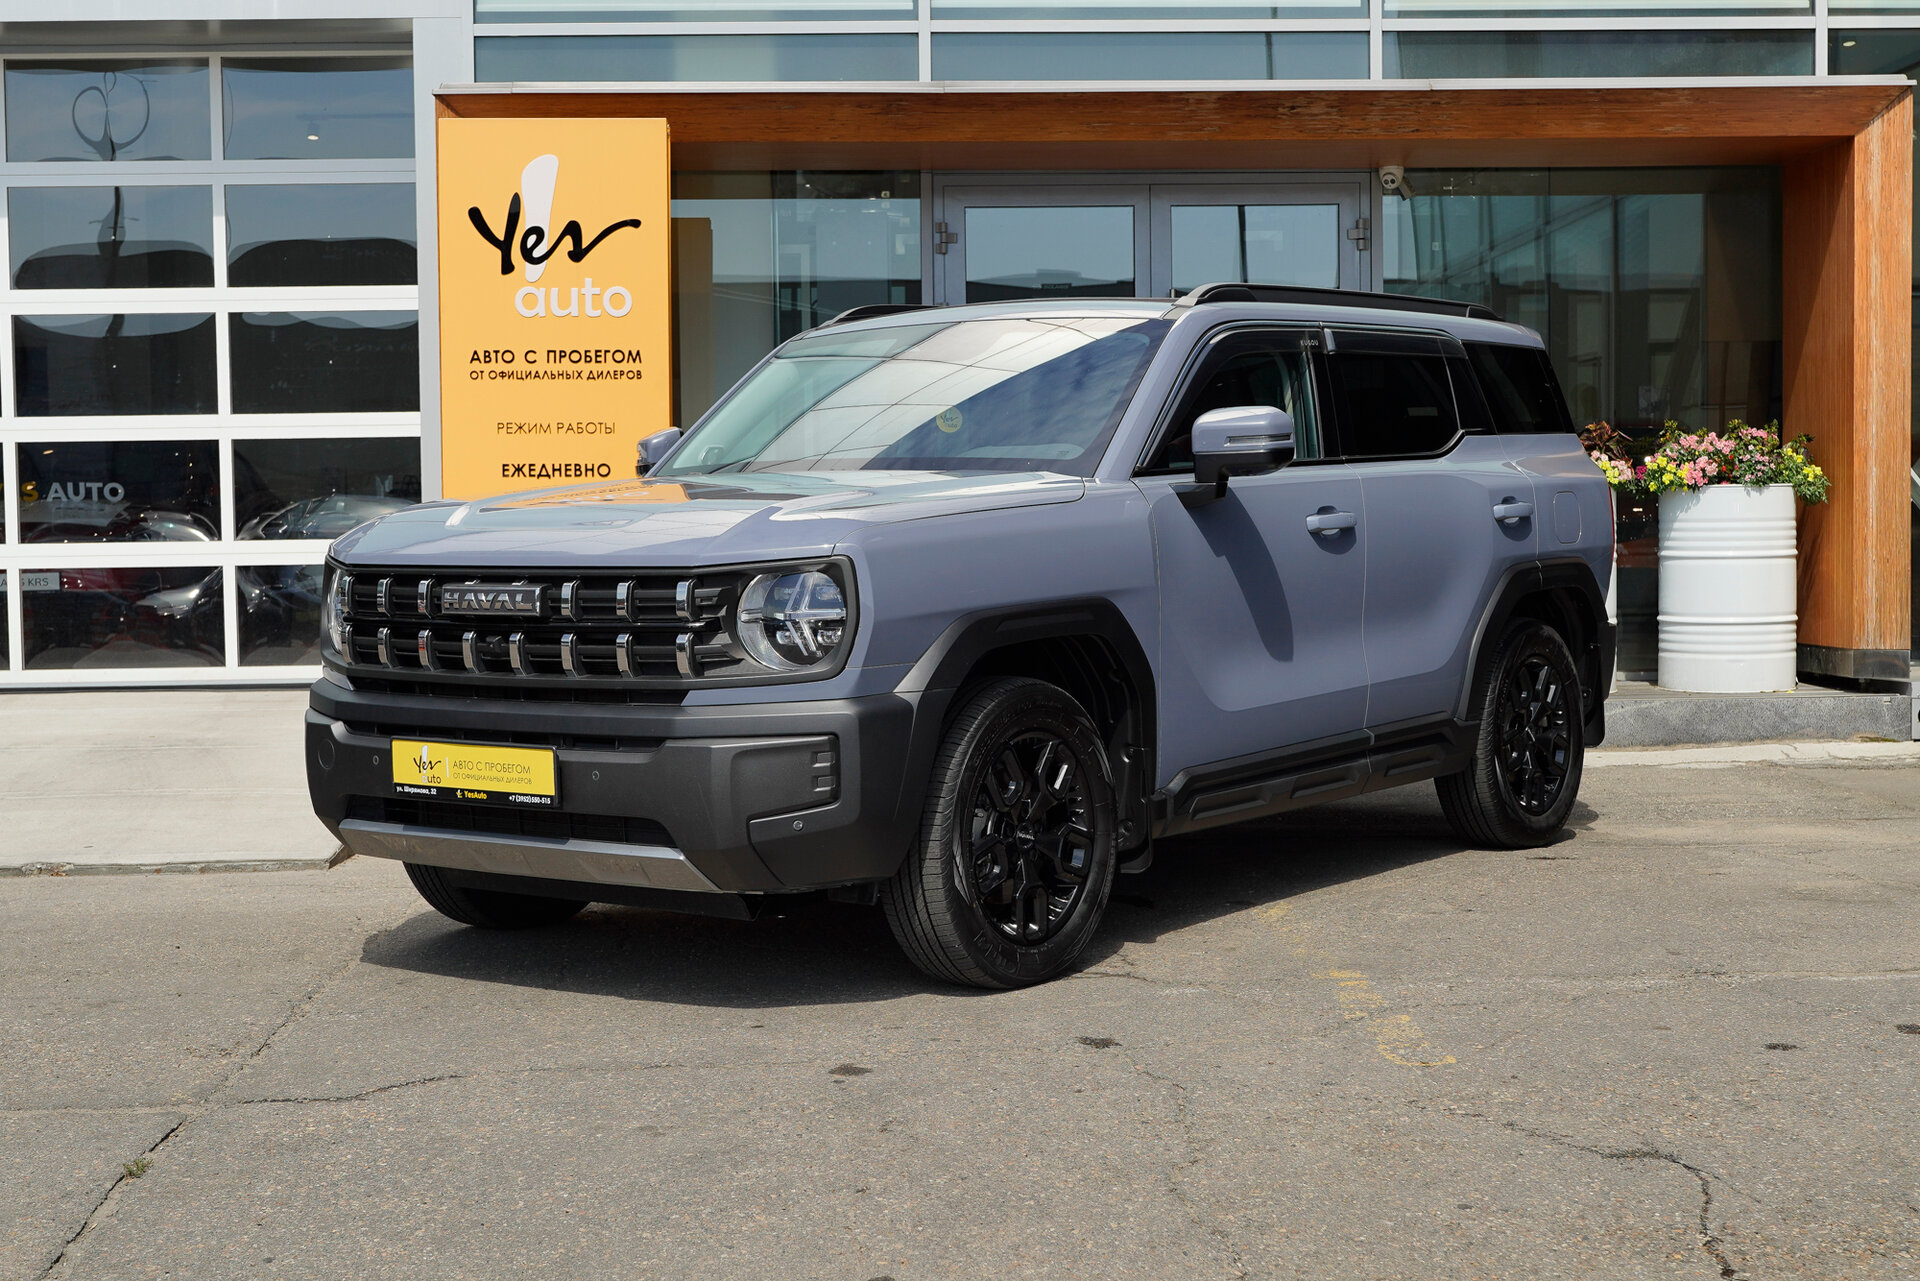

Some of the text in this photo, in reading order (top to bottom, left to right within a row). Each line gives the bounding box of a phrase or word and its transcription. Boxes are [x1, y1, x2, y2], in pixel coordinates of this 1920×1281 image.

[468, 192, 641, 275] Yes
[515, 278, 633, 318] auto
[470, 350, 642, 364] АВТО С ПРОБЕГОМ
[470, 370, 642, 381] ОТ ОФИЦИАЛЬНЫХ ДИЛЕРОВ
[497, 422, 615, 434] РЕЖИМ РАБОТЫ
[502, 463, 611, 479] ЕЖЕДНЕВНО
[46, 482, 125, 502] AUTO
[28, 577, 49, 586] KRS
[444, 592, 533, 609] HAVAL
[413, 755, 441, 773] Yes
[453, 760, 531, 774] АВТО С ПРОБЕГОМ
[422, 774, 441, 784] auto
[462, 773, 505, 783] ОФИЦИАЛЬНЫХ
[464, 790, 488, 800] YesAuto
